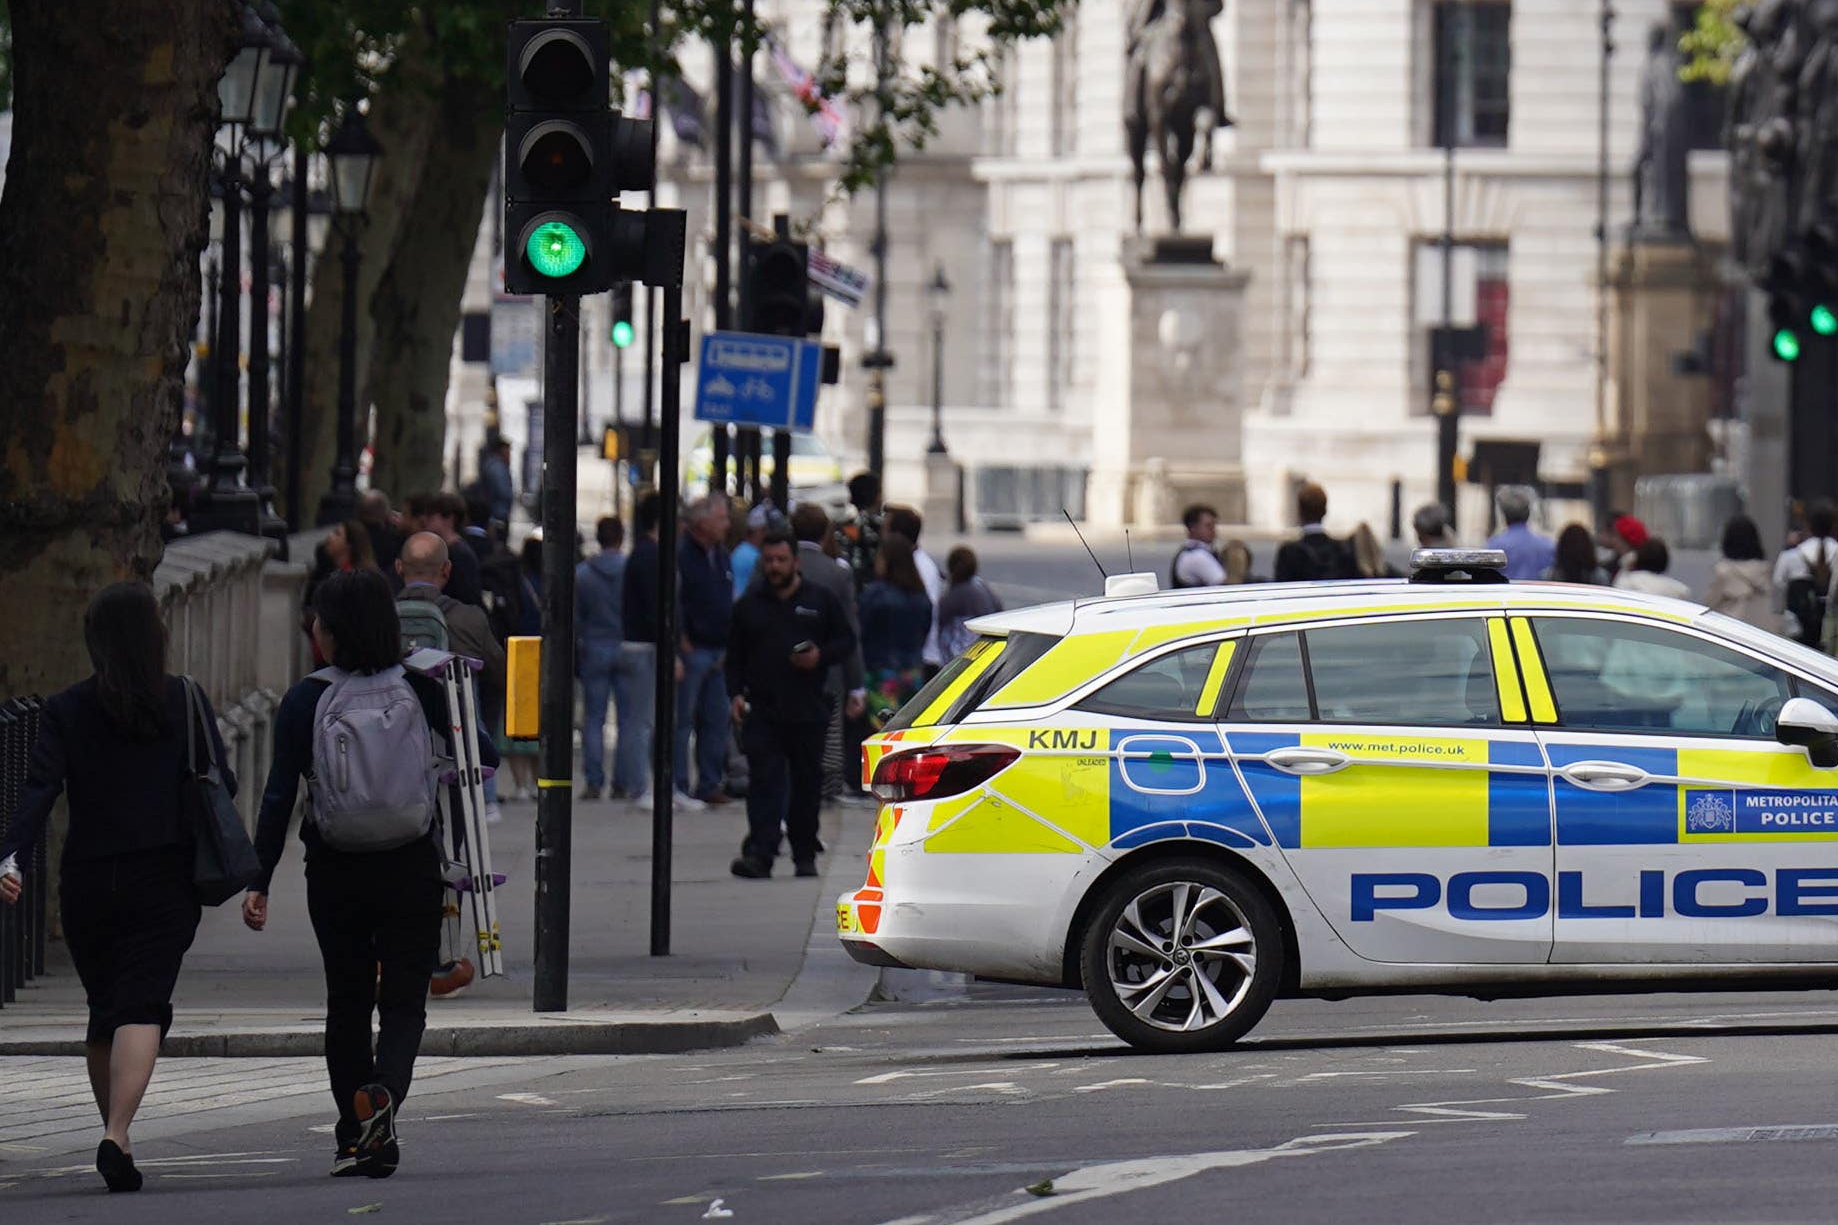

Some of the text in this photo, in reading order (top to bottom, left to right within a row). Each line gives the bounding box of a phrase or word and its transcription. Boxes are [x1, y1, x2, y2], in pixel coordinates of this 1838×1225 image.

[1029, 729, 1097, 750] KMJ
[1328, 741, 1465, 756] www.met.police.uk
[1077, 758, 1106, 766] UNLEADED
[1761, 811, 1835, 826] POLICE
